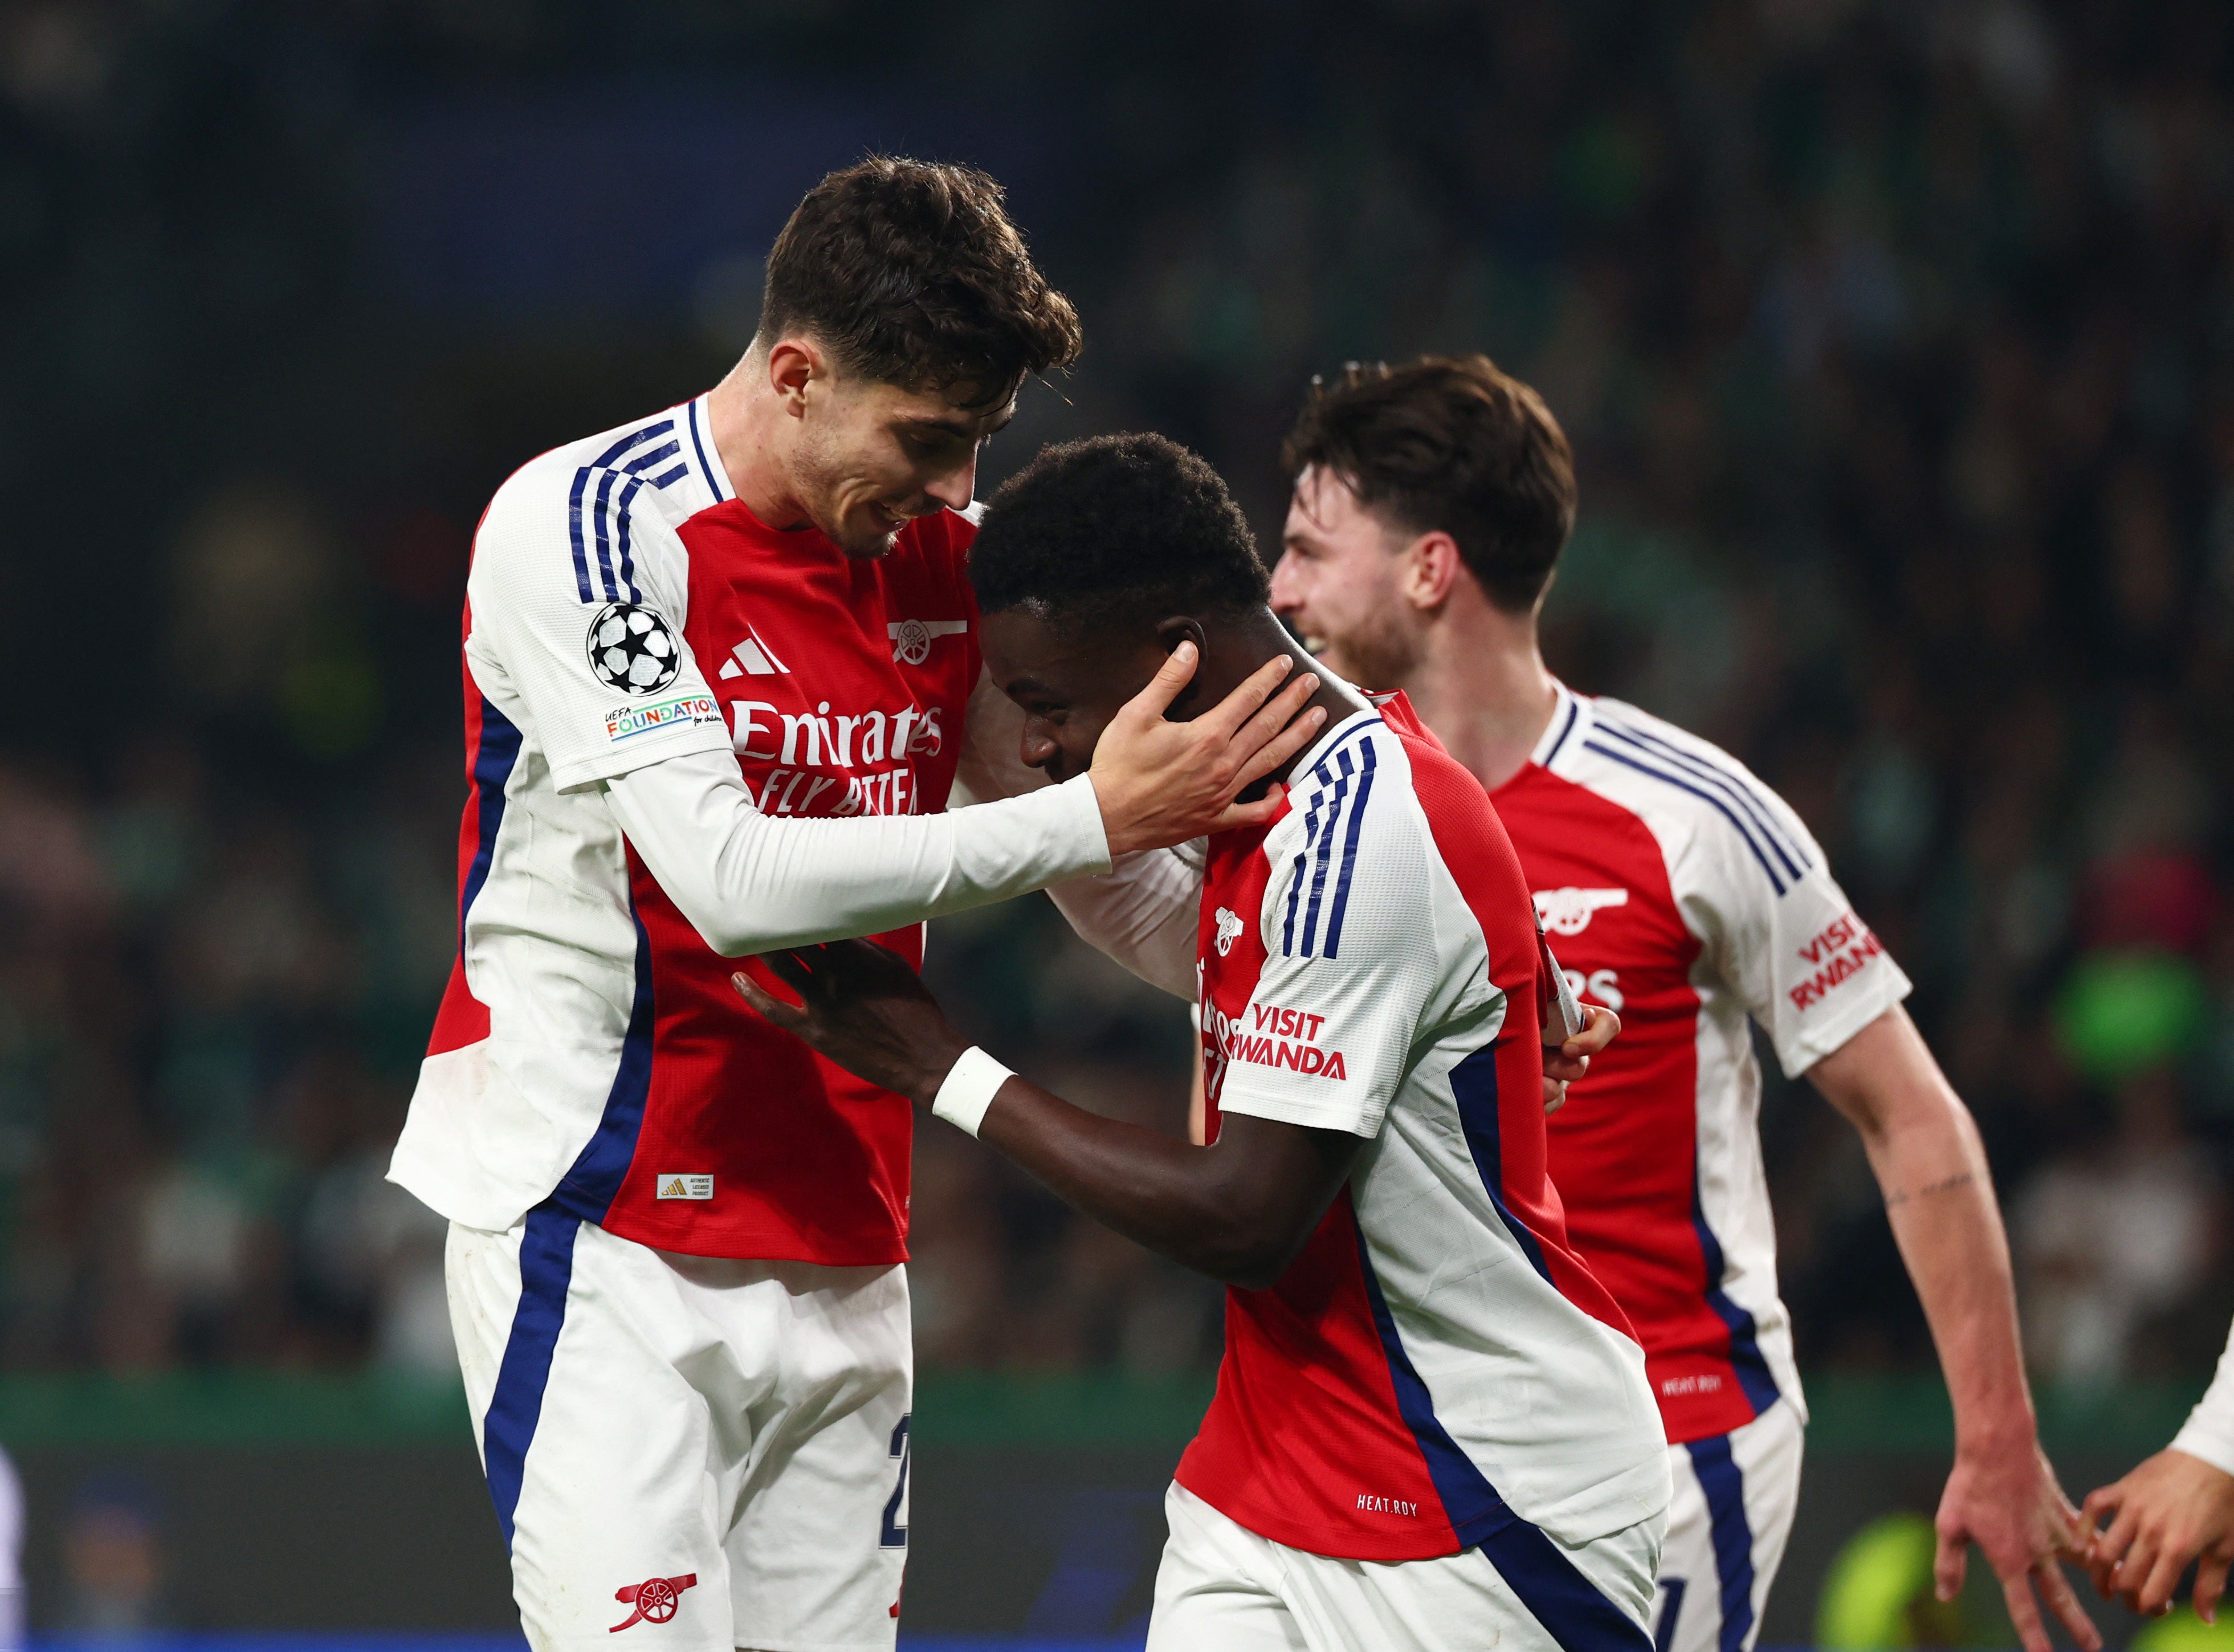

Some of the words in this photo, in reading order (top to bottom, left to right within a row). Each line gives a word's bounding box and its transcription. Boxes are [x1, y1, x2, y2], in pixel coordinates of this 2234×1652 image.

[605, 707, 631, 722] UEFA
[607, 699, 719, 737] FOUNDATION
[694, 716, 702, 727] for
[757, 769, 836, 813] FLY
[1253, 1003, 1324, 1041] VISIT
[1230, 1034, 1346, 1080] RWANDA
[1357, 1494, 1417, 1517] HEAT.RDY
